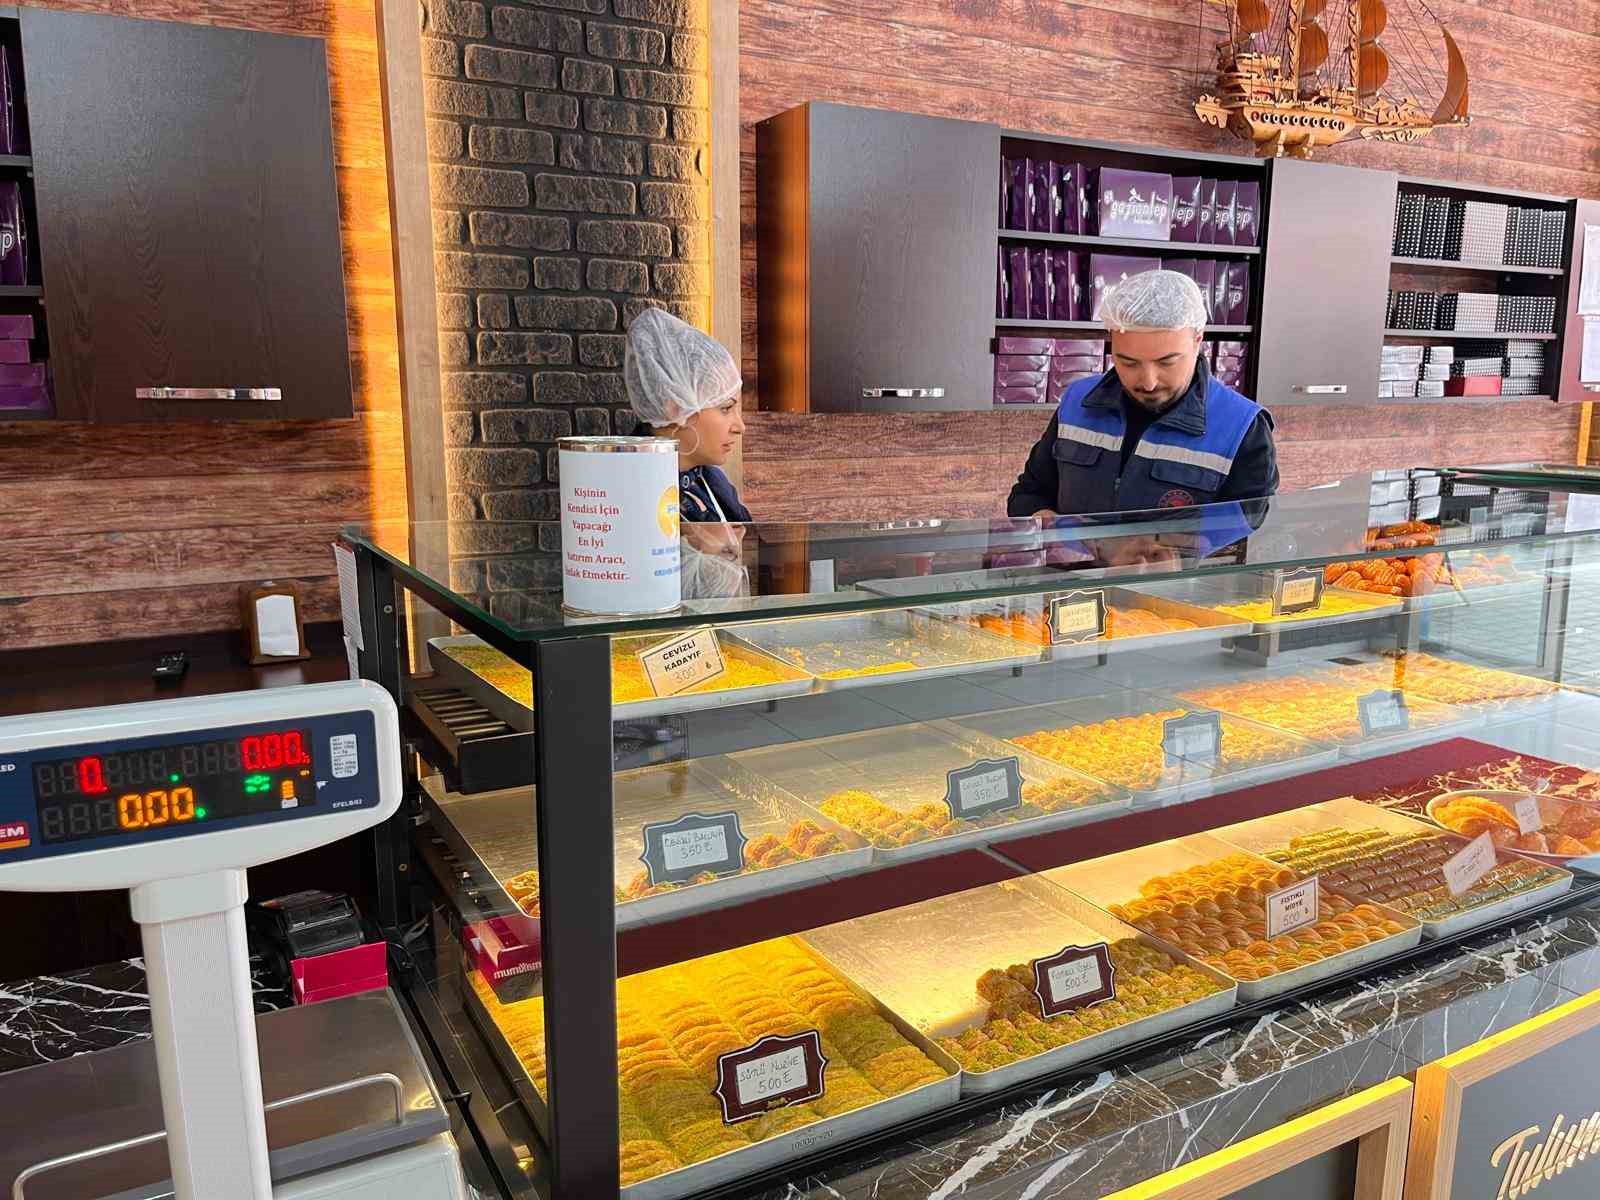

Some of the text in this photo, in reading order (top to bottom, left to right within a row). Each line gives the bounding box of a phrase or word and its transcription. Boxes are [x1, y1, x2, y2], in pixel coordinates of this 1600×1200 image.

[574, 486, 608, 499] Kişinin
[567, 502, 620, 516] Kendisi İçin
[572, 519, 612, 534] Yapacağı
[578, 535, 604, 549] En İyi
[119, 786, 195, 829] 0.00
[758, 1078, 782, 1095] 500
